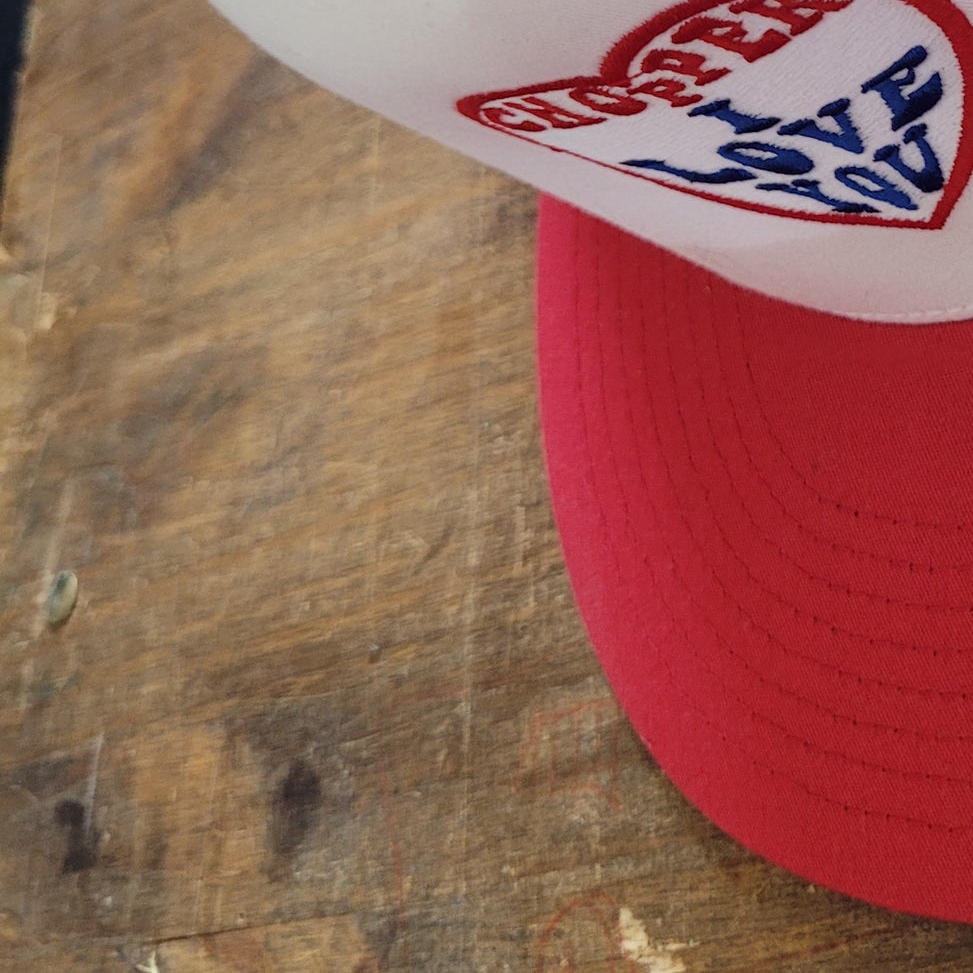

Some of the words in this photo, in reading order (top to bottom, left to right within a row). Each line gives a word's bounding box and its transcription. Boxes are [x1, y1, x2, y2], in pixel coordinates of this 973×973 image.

[620, 44, 944, 184] LOVE
[687, 98, 781, 135] I
[755, 123, 945, 214] YOU
